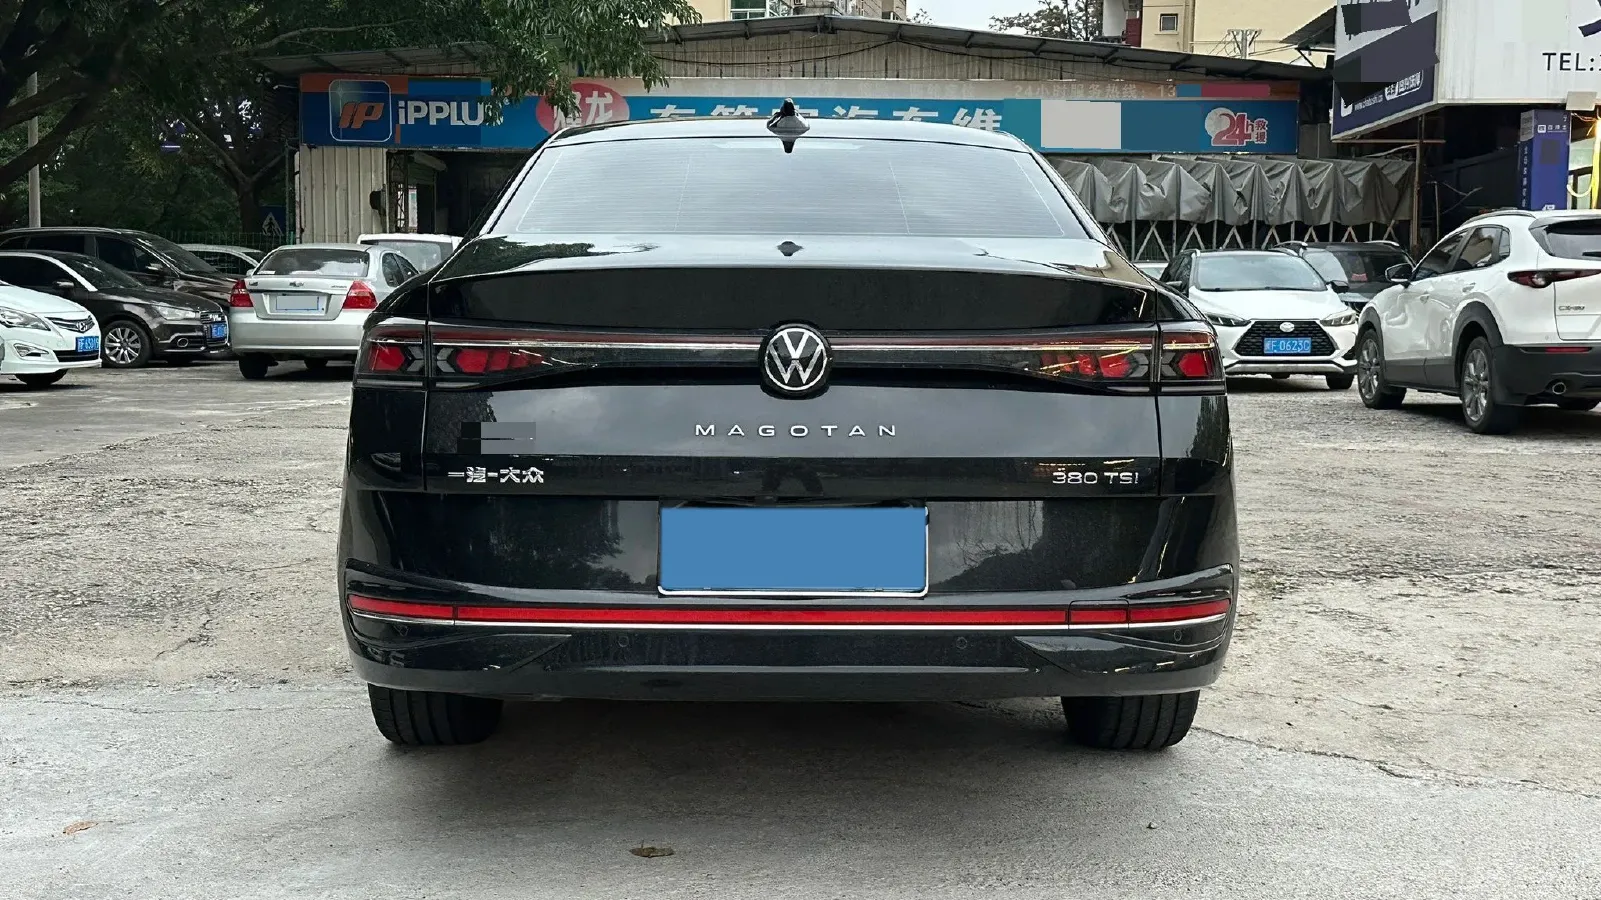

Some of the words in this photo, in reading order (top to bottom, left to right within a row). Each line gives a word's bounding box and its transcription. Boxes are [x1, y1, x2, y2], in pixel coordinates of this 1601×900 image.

[694, 424, 897, 437] MAGOTAN
[1053, 471, 1098, 484] 380
[1104, 471, 1139, 484] TSI
